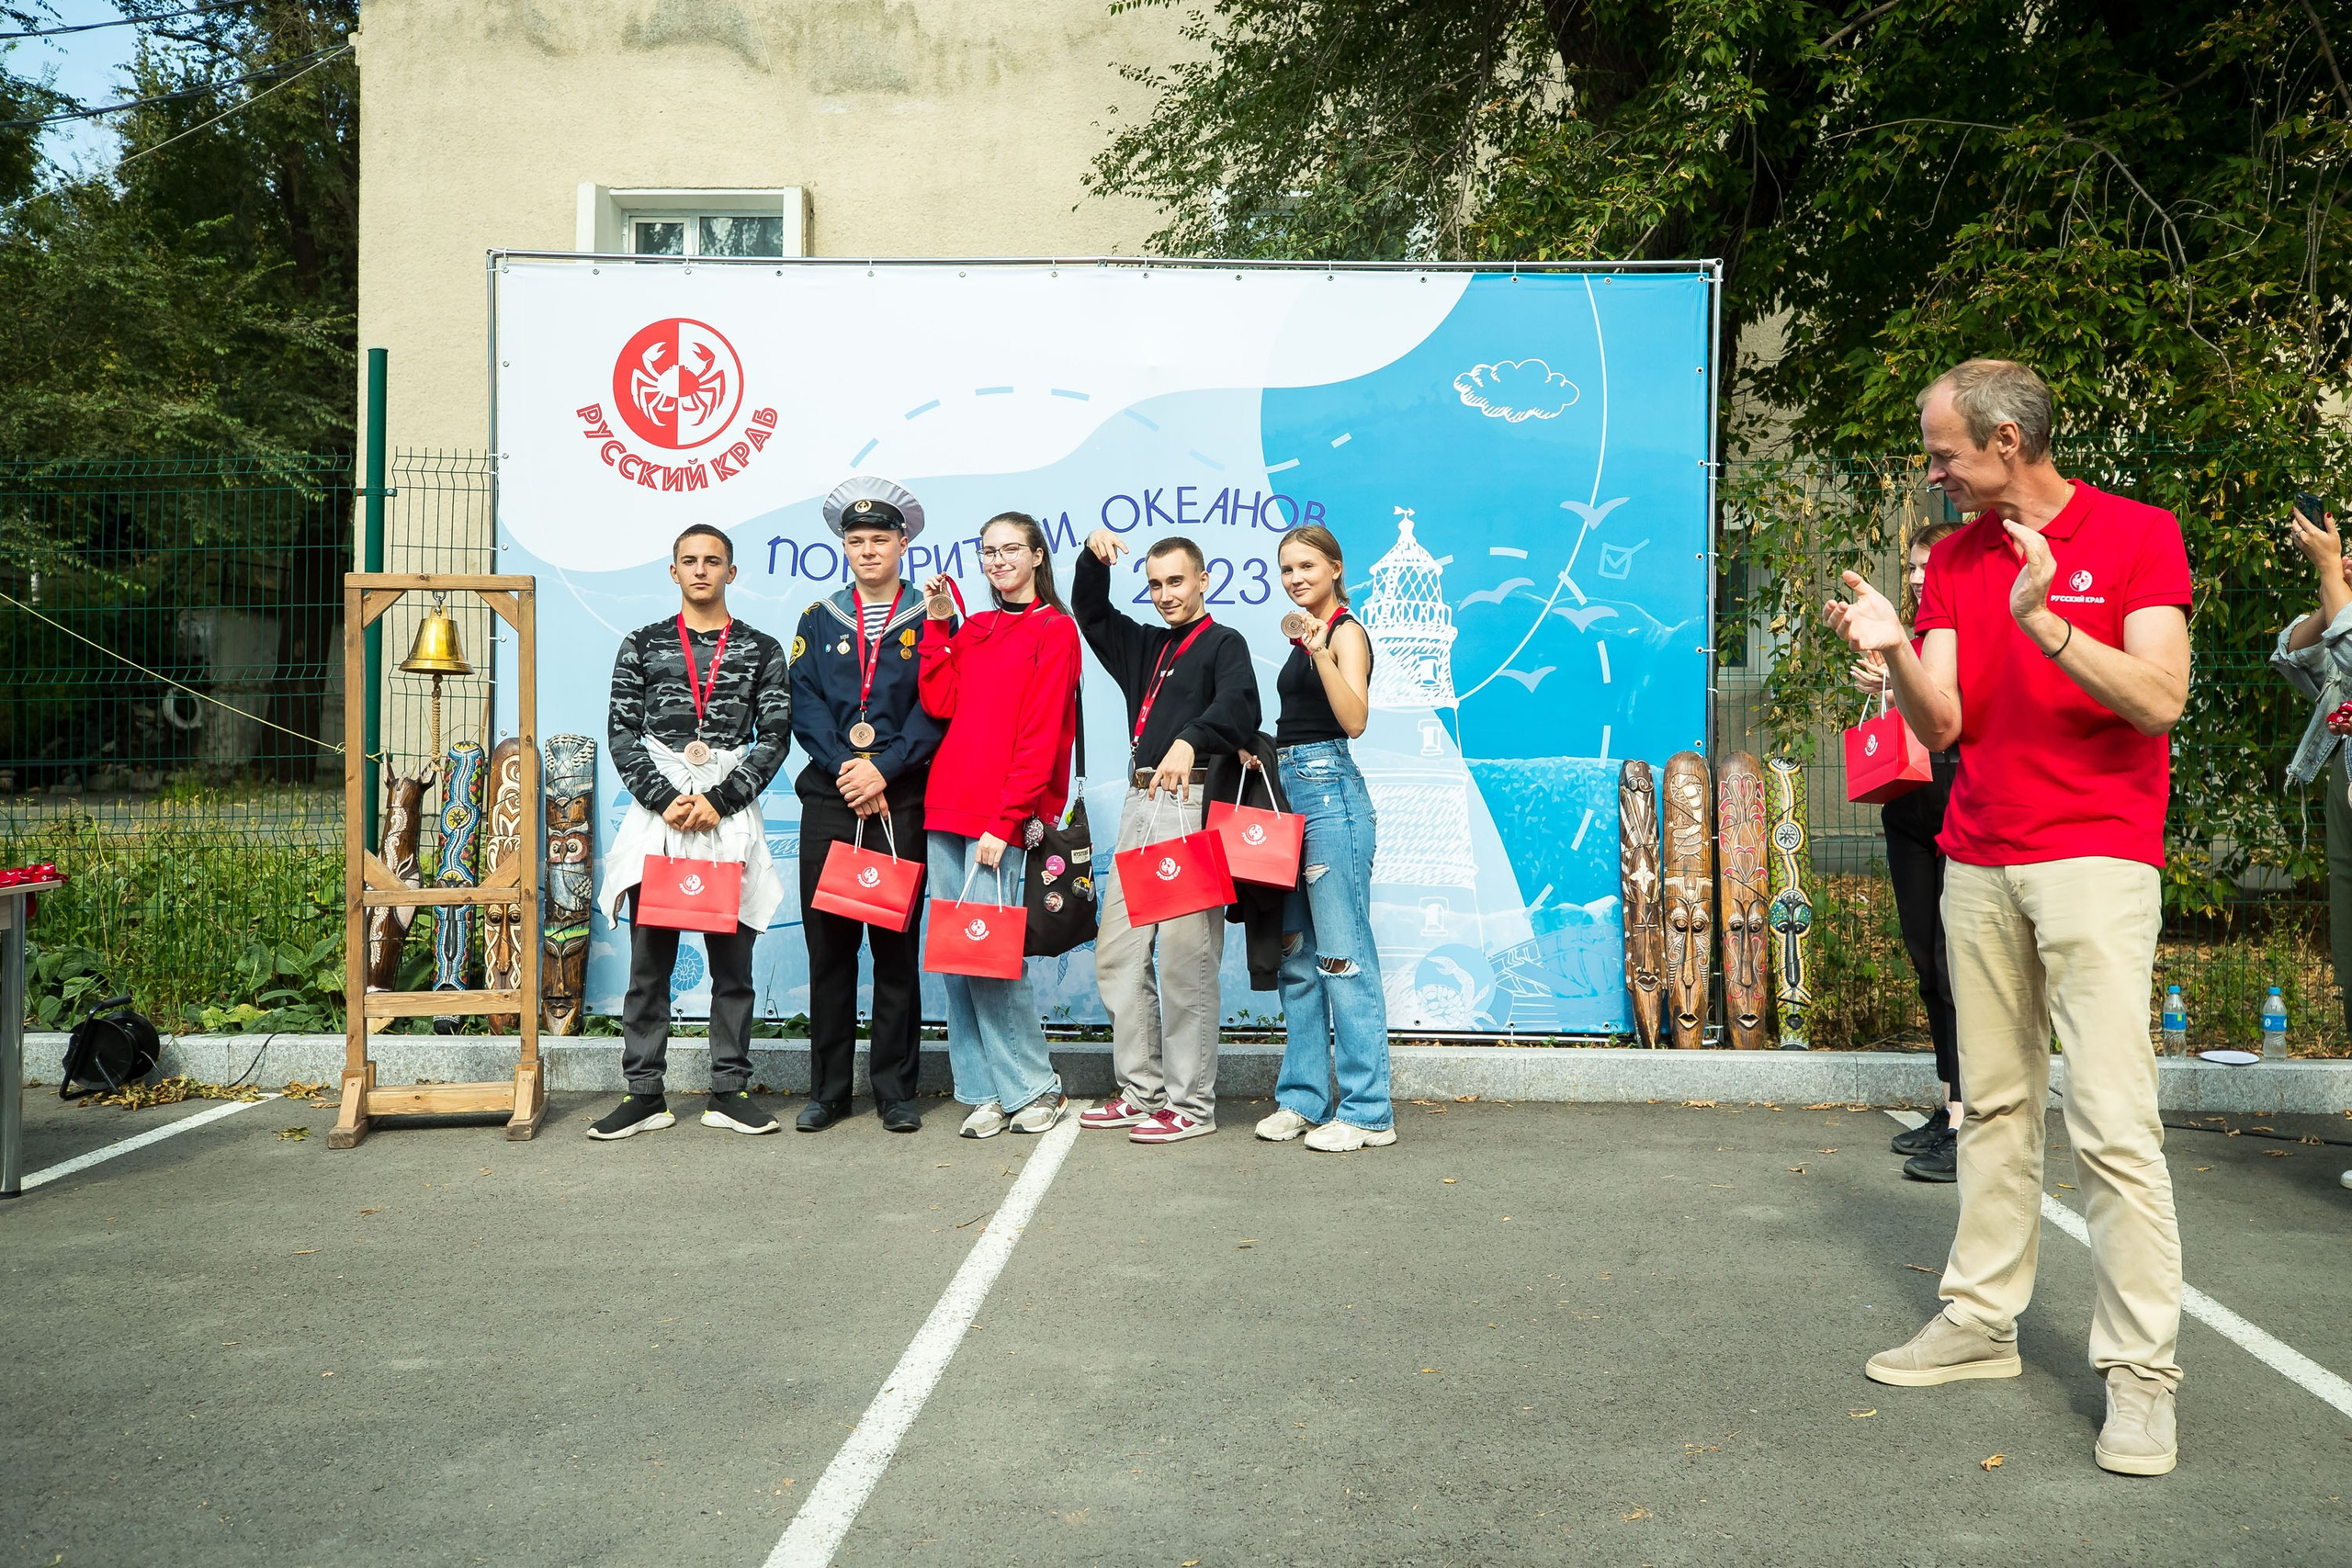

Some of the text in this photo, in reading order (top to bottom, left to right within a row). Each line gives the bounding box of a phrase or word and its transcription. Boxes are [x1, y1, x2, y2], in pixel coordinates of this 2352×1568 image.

[576, 402, 778, 492] РУССКИЙ КРАБ
[1101, 486, 1328, 533] ОКЕАНОВ
[1131, 557, 1272, 605] 223
[2050, 594, 2106, 604] РУССКИЙ КРАБ
